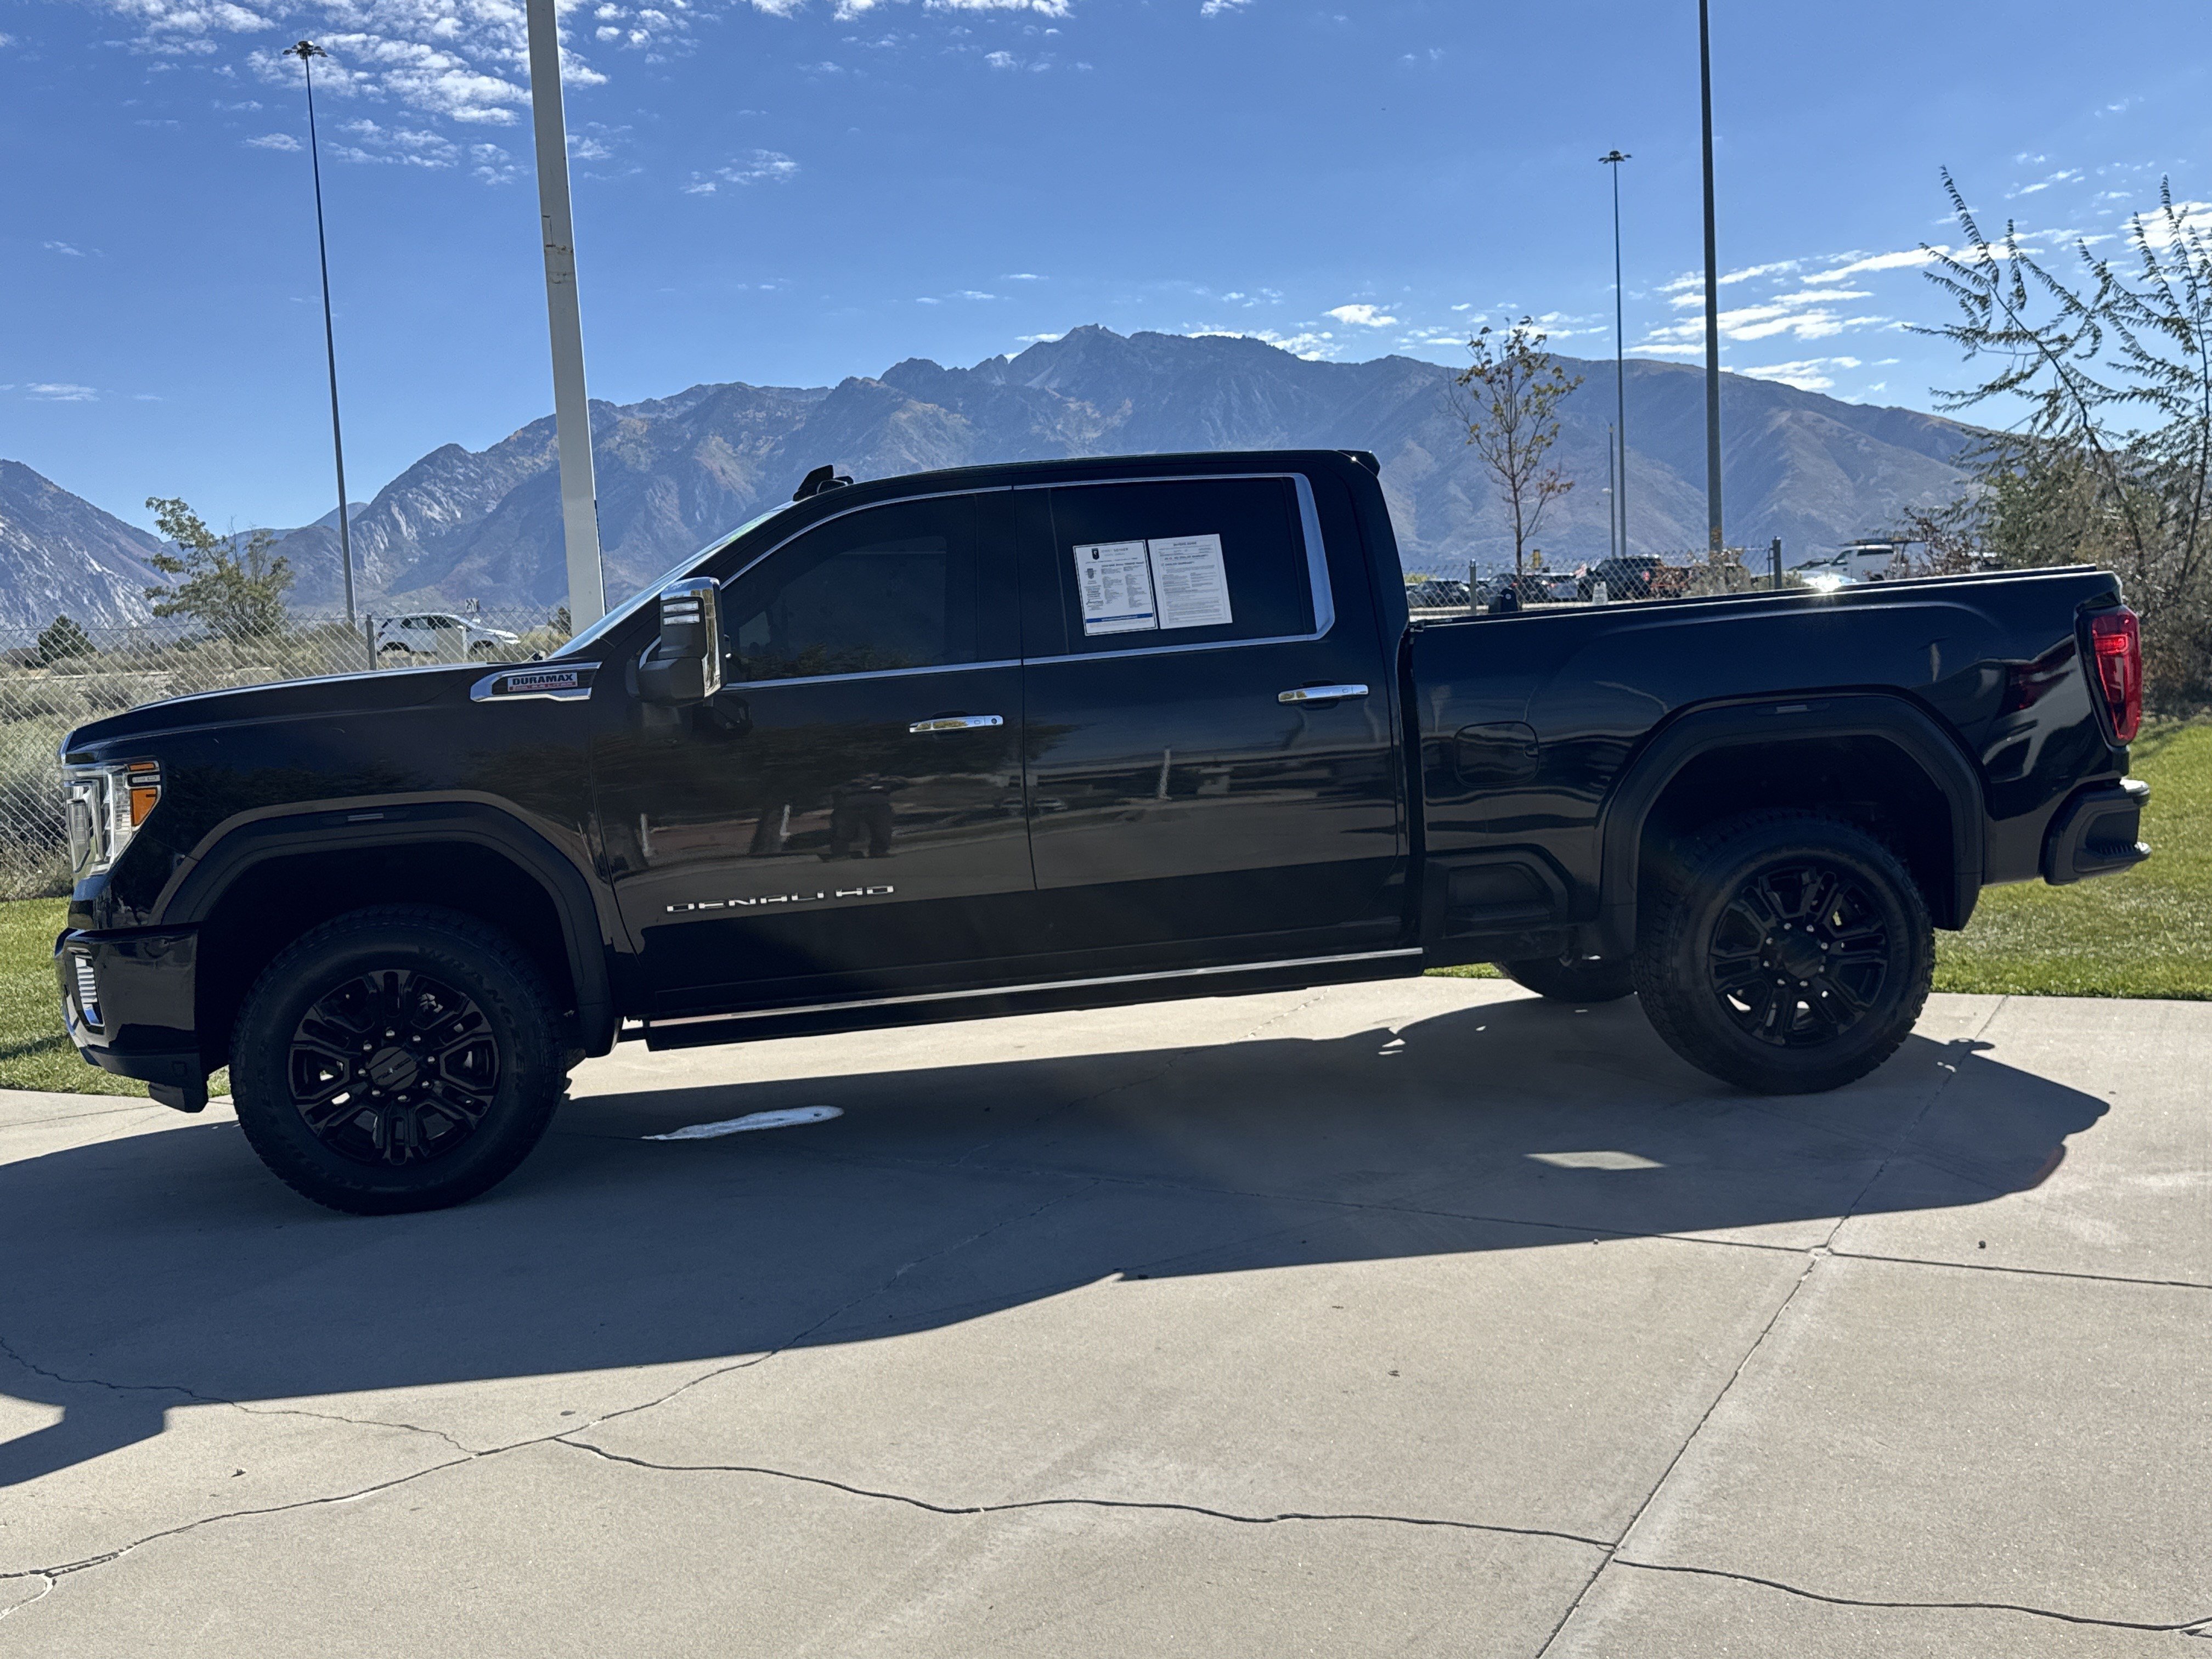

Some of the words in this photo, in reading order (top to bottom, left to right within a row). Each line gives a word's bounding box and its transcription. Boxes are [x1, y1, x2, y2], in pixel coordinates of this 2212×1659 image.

[512, 674, 573, 685] DURAMAX
[666, 891, 824, 912] DENALI
[836, 885, 894, 898] HD
[419, 945, 525, 1088] WRANGLER
